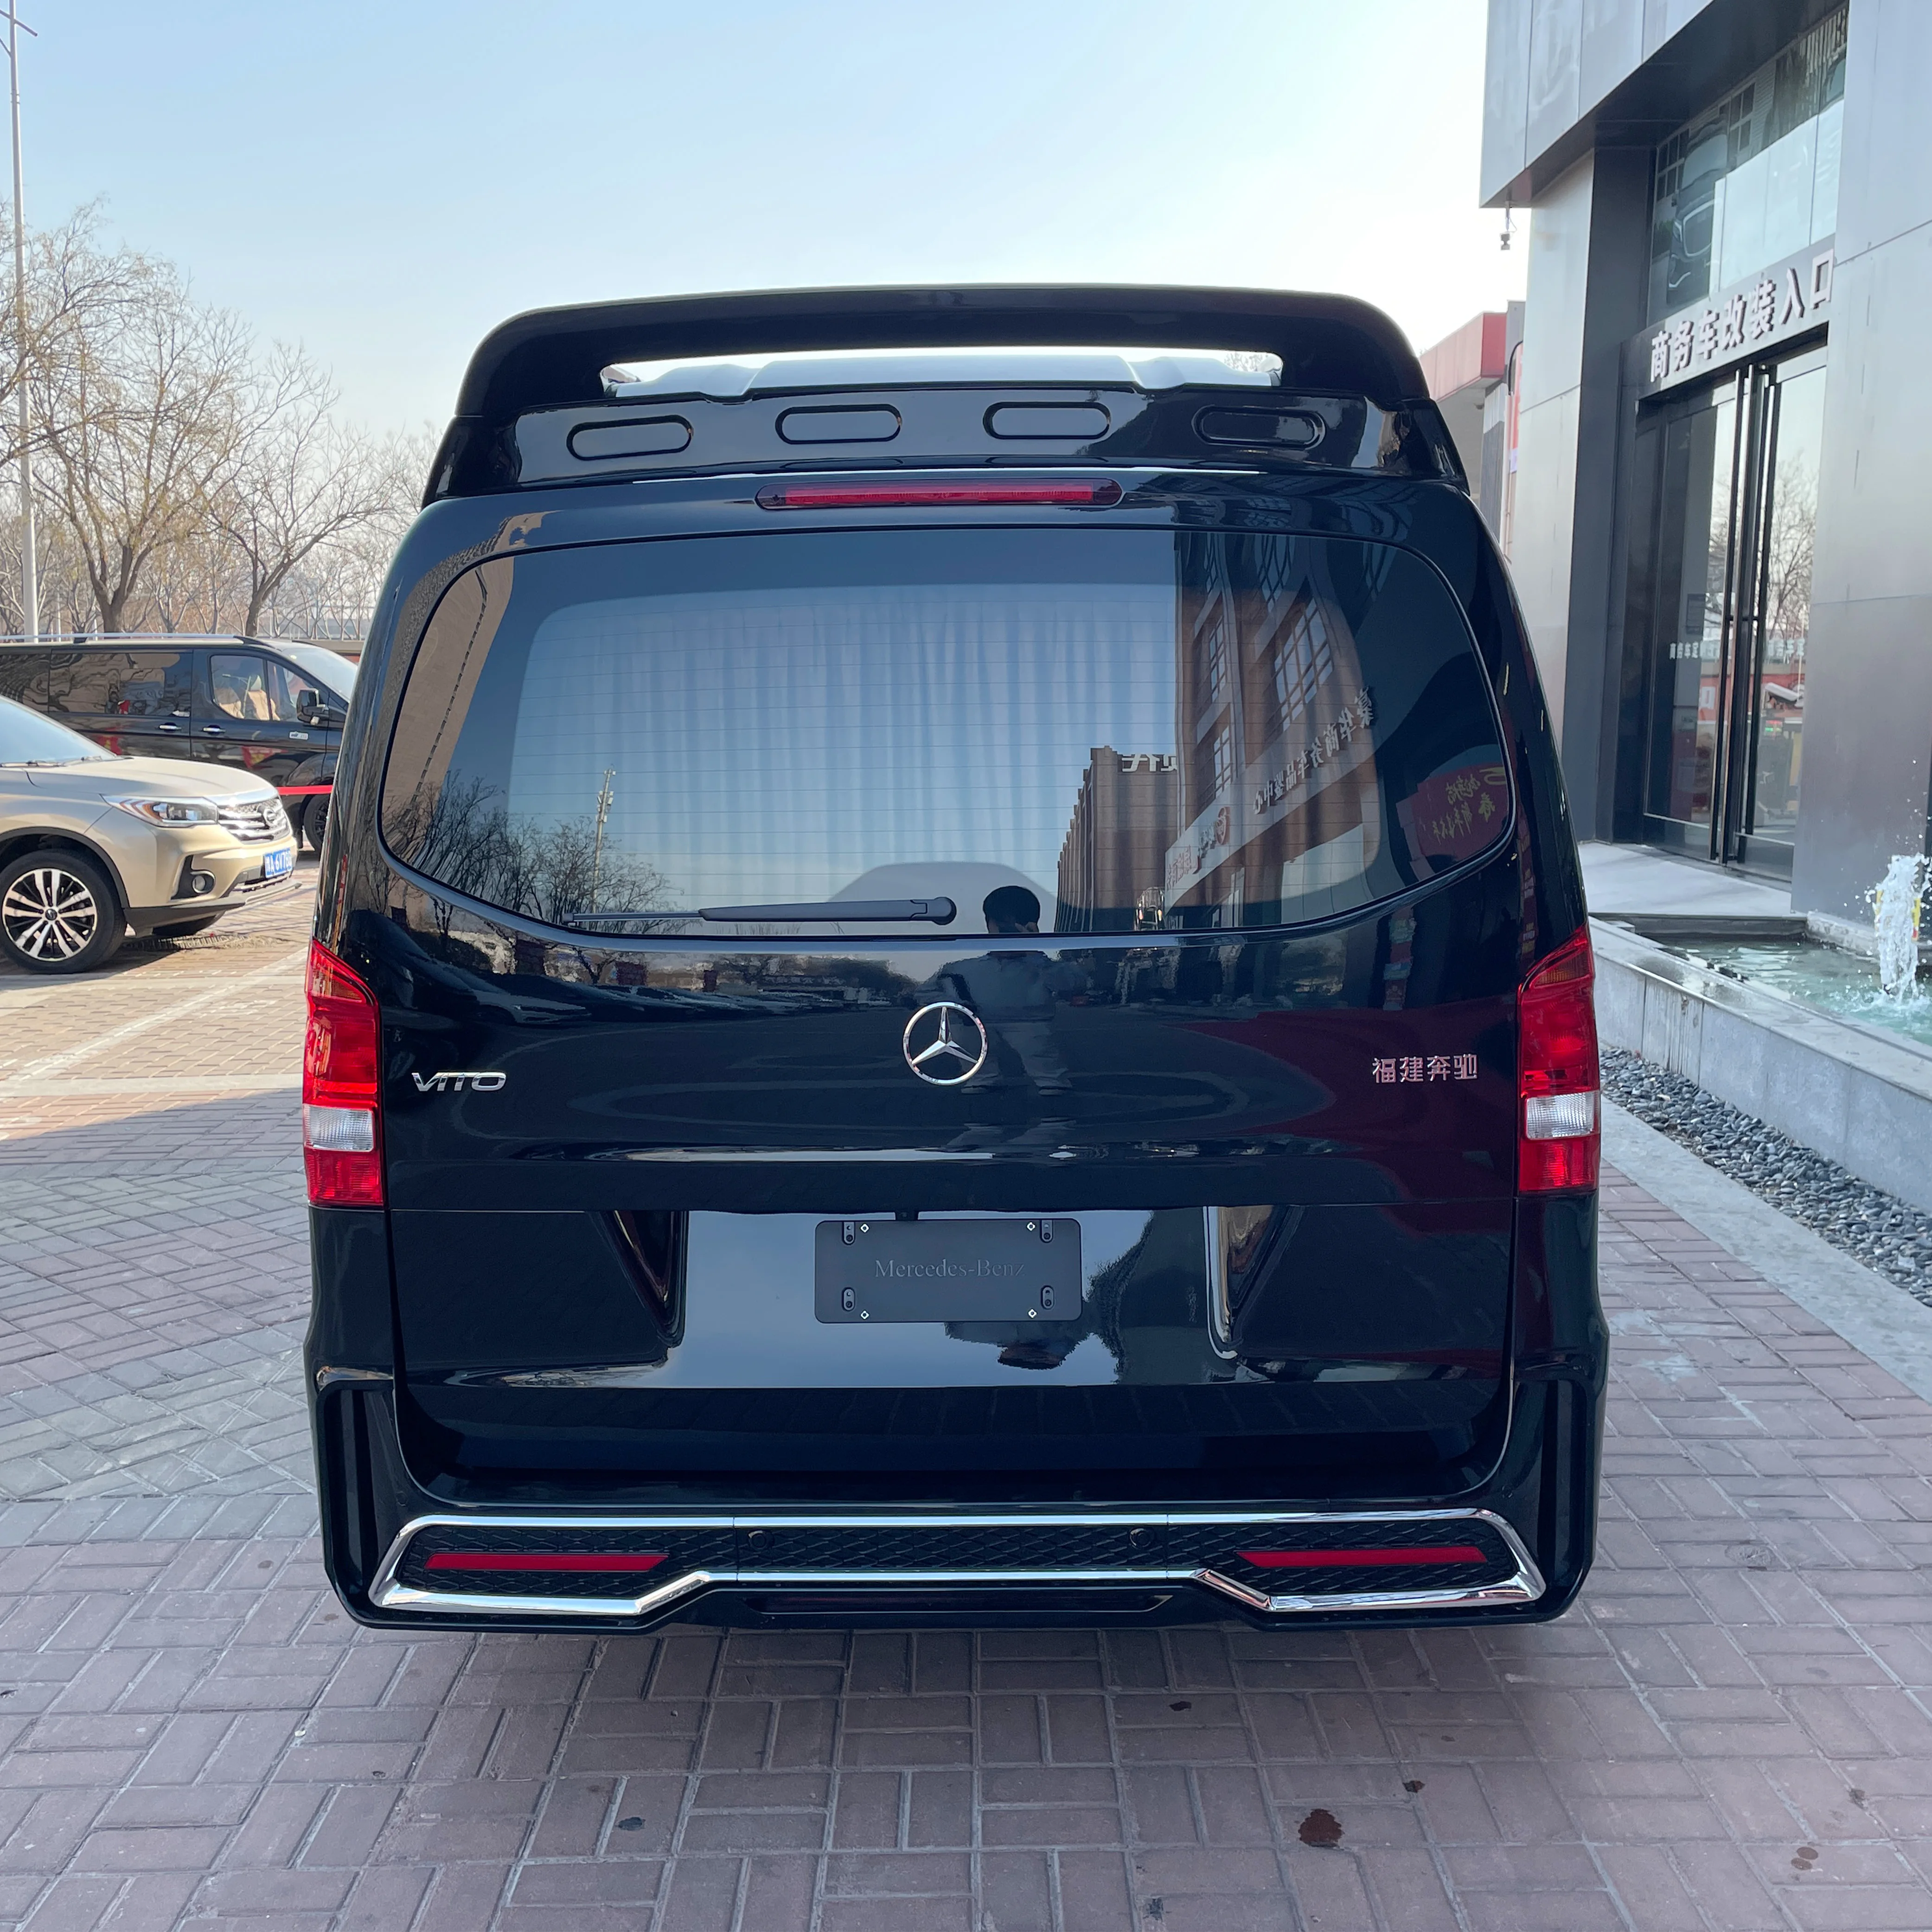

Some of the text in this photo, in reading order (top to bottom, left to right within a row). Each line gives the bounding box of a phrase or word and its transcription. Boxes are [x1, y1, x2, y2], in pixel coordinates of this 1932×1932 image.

[1650, 249, 1834, 383] 商务车改装入口
[1372, 1054, 1478, 1083] 福建奔驰
[411, 1072, 506, 1091] VITO
[875, 1259, 1025, 1278] Mercedes-Benz
